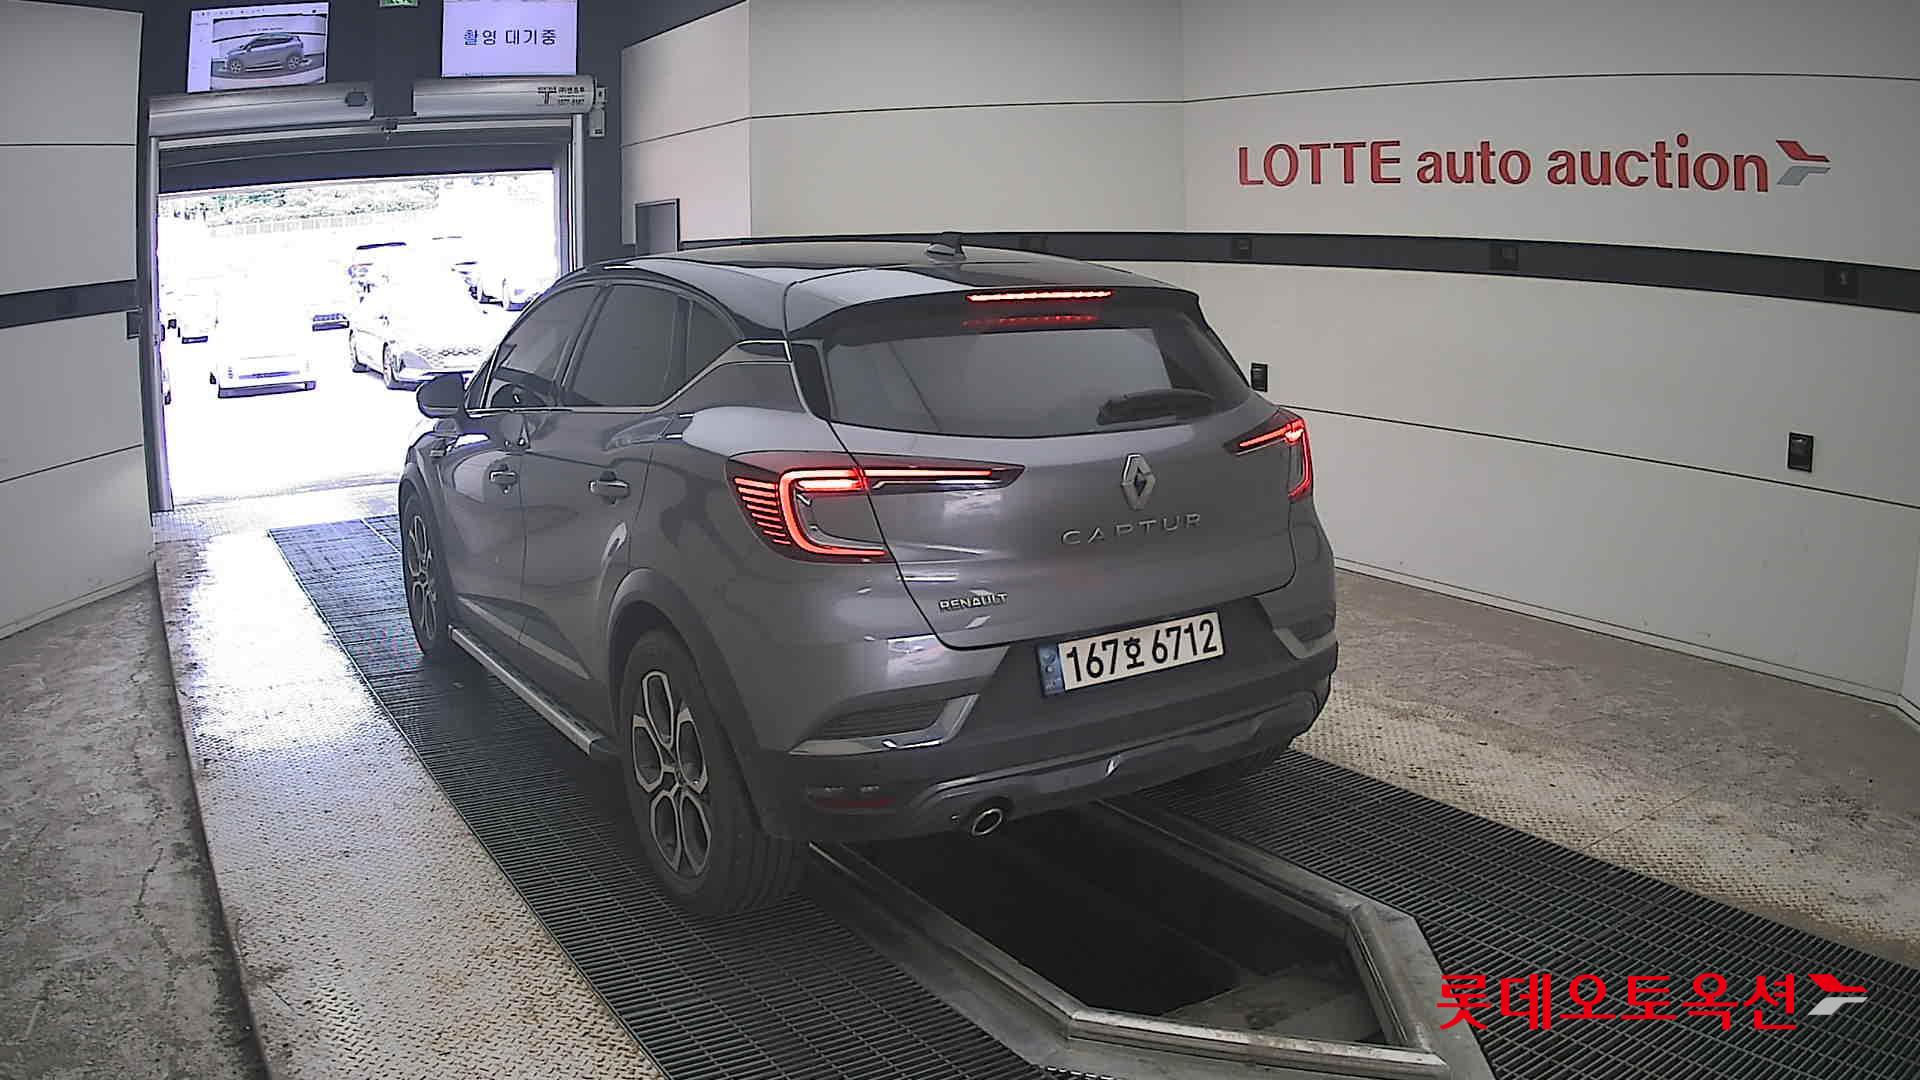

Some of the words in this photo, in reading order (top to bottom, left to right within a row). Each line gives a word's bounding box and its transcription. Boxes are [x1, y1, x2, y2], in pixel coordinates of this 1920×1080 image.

[505, 29, 556, 46] 대기중
[1239, 141, 1401, 187] LOTTE
[1417, 141, 1532, 185] auto
[1546, 133, 1769, 193] auction
[1061, 513, 1201, 545] CAPTUR
[938, 592, 1008, 612] RENAULT
[1066, 637, 1144, 682] 167호
[1150, 619, 1218, 664] 6712
